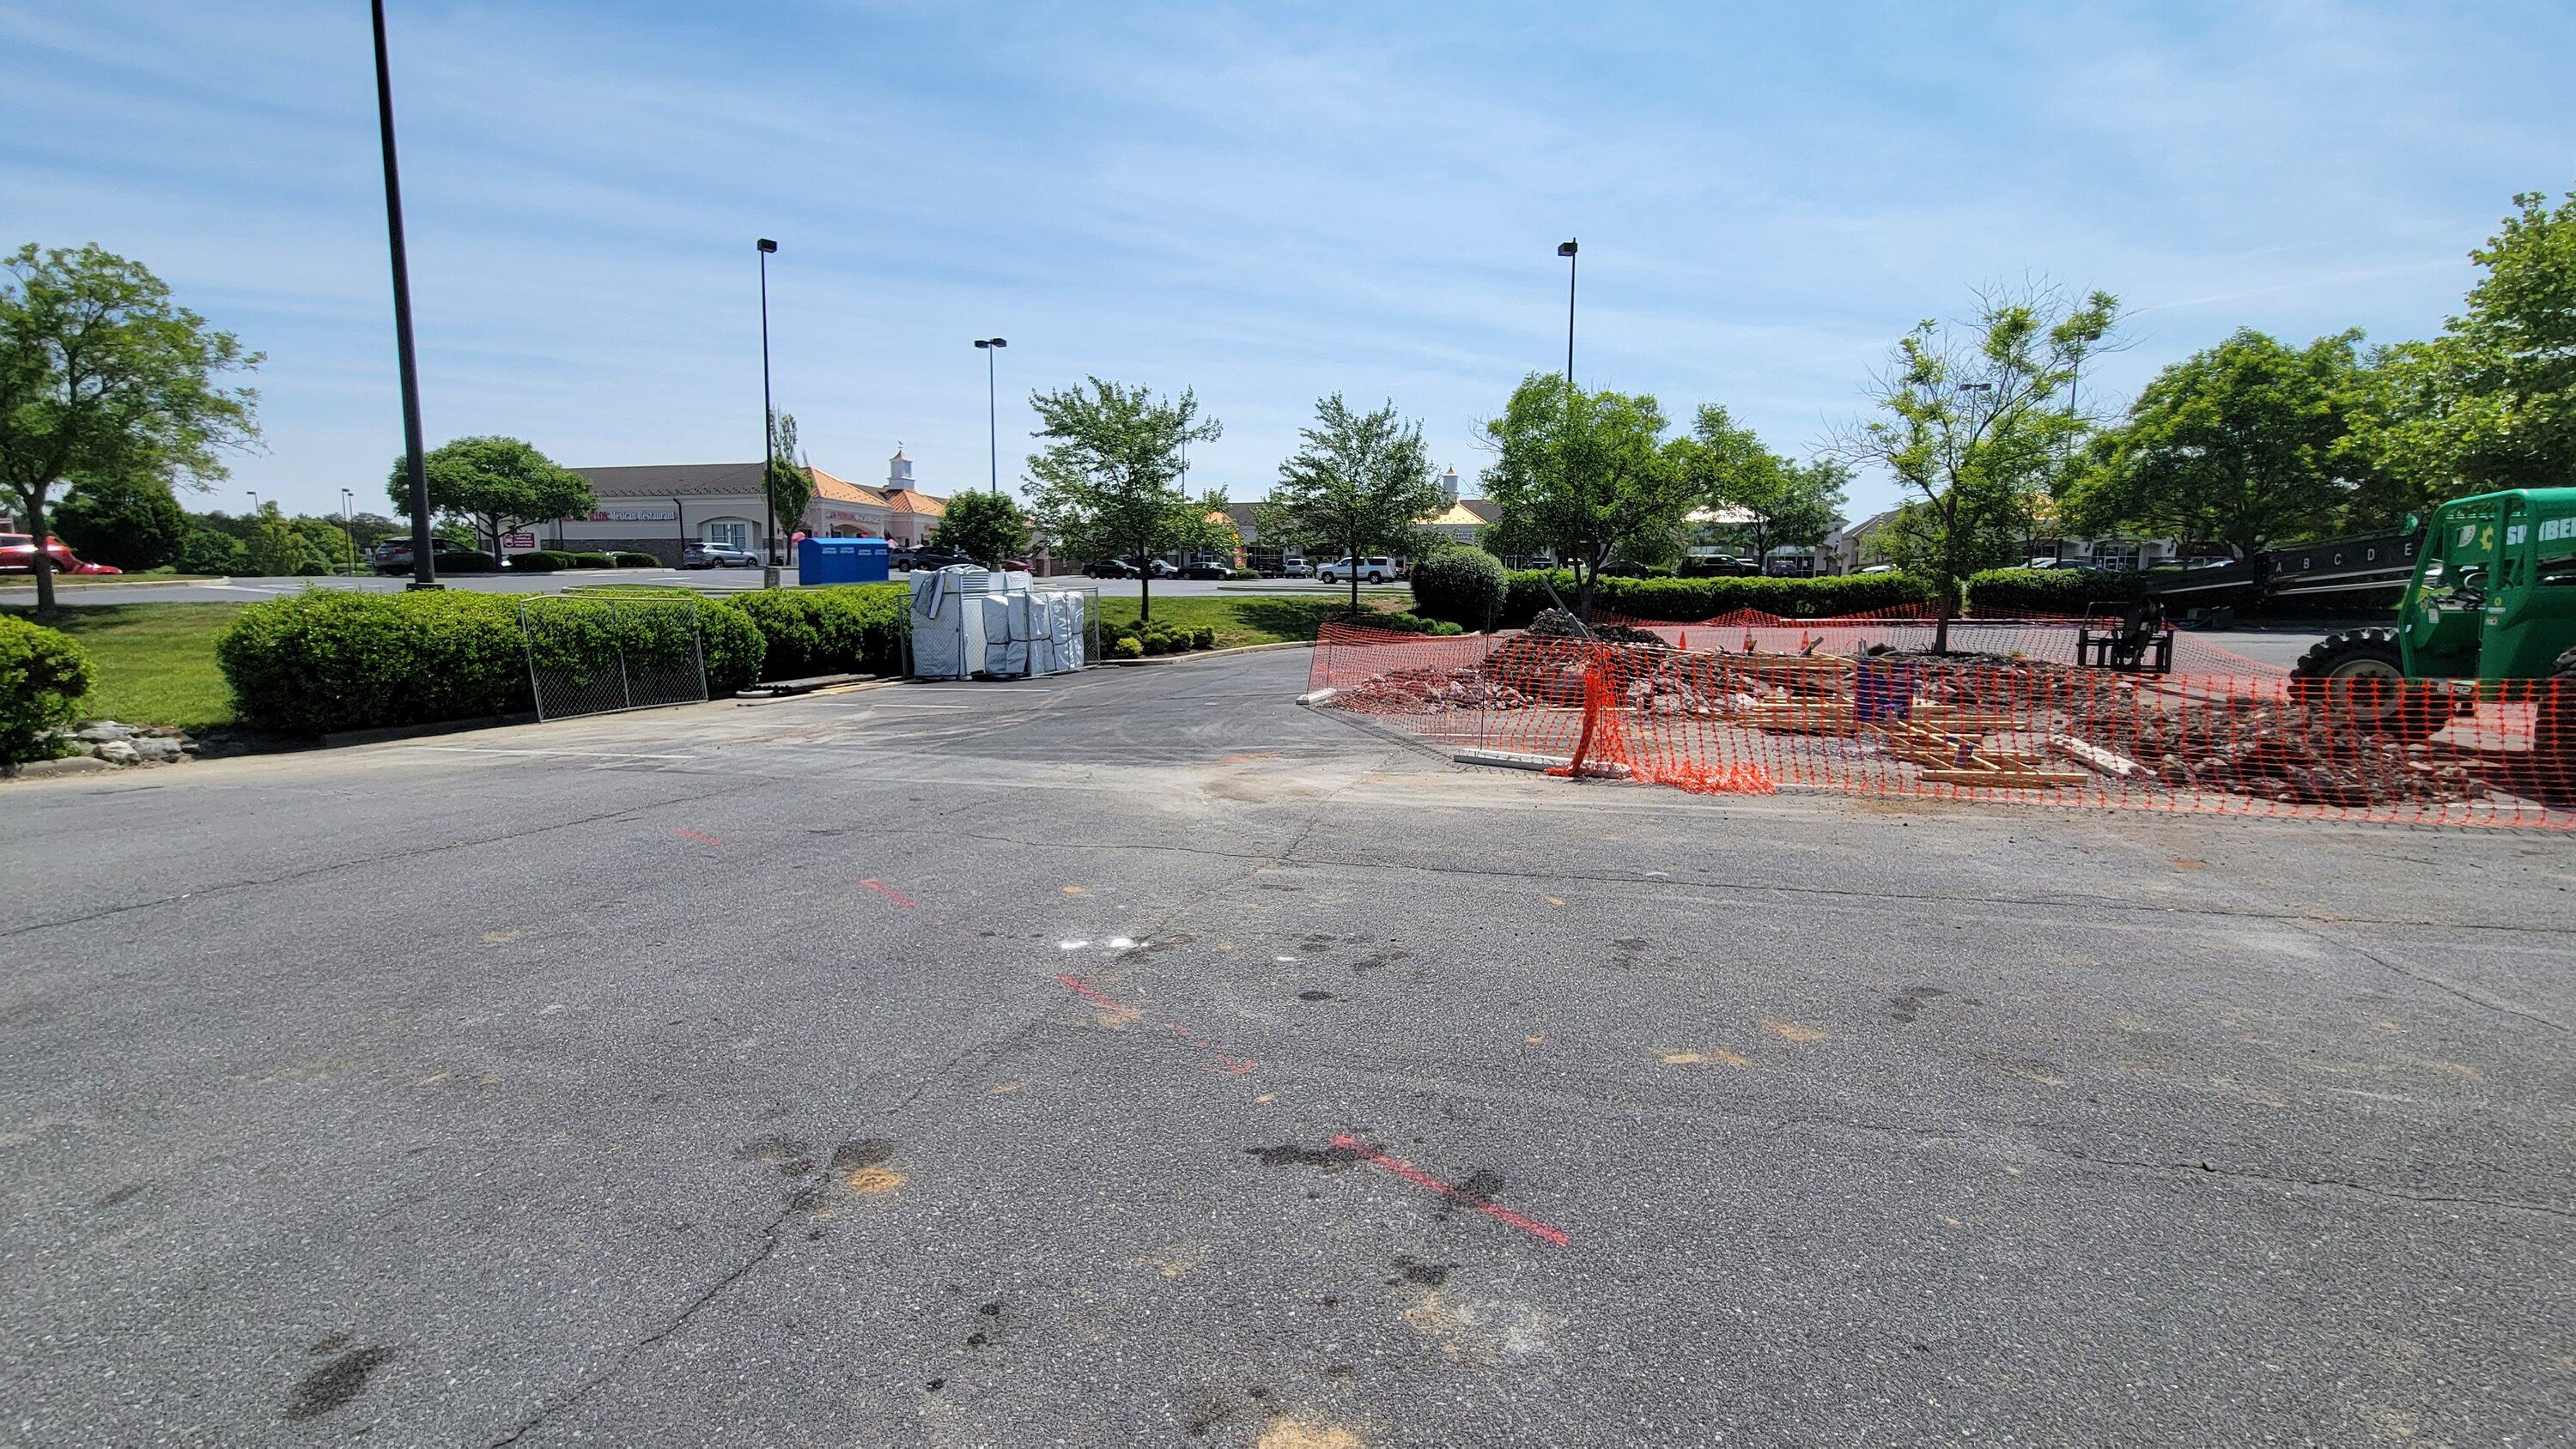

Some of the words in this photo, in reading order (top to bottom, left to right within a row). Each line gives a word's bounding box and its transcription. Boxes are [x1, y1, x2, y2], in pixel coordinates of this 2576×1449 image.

[610, 510, 636, 520] Mexican
[638, 510, 675, 520] Restaurant
[2275, 561, 2282, 573] A
[2303, 558, 2310, 569] B
[2334, 553, 2342, 566] C
[2367, 549, 2375, 561] D
[2404, 543, 2412, 556] E
